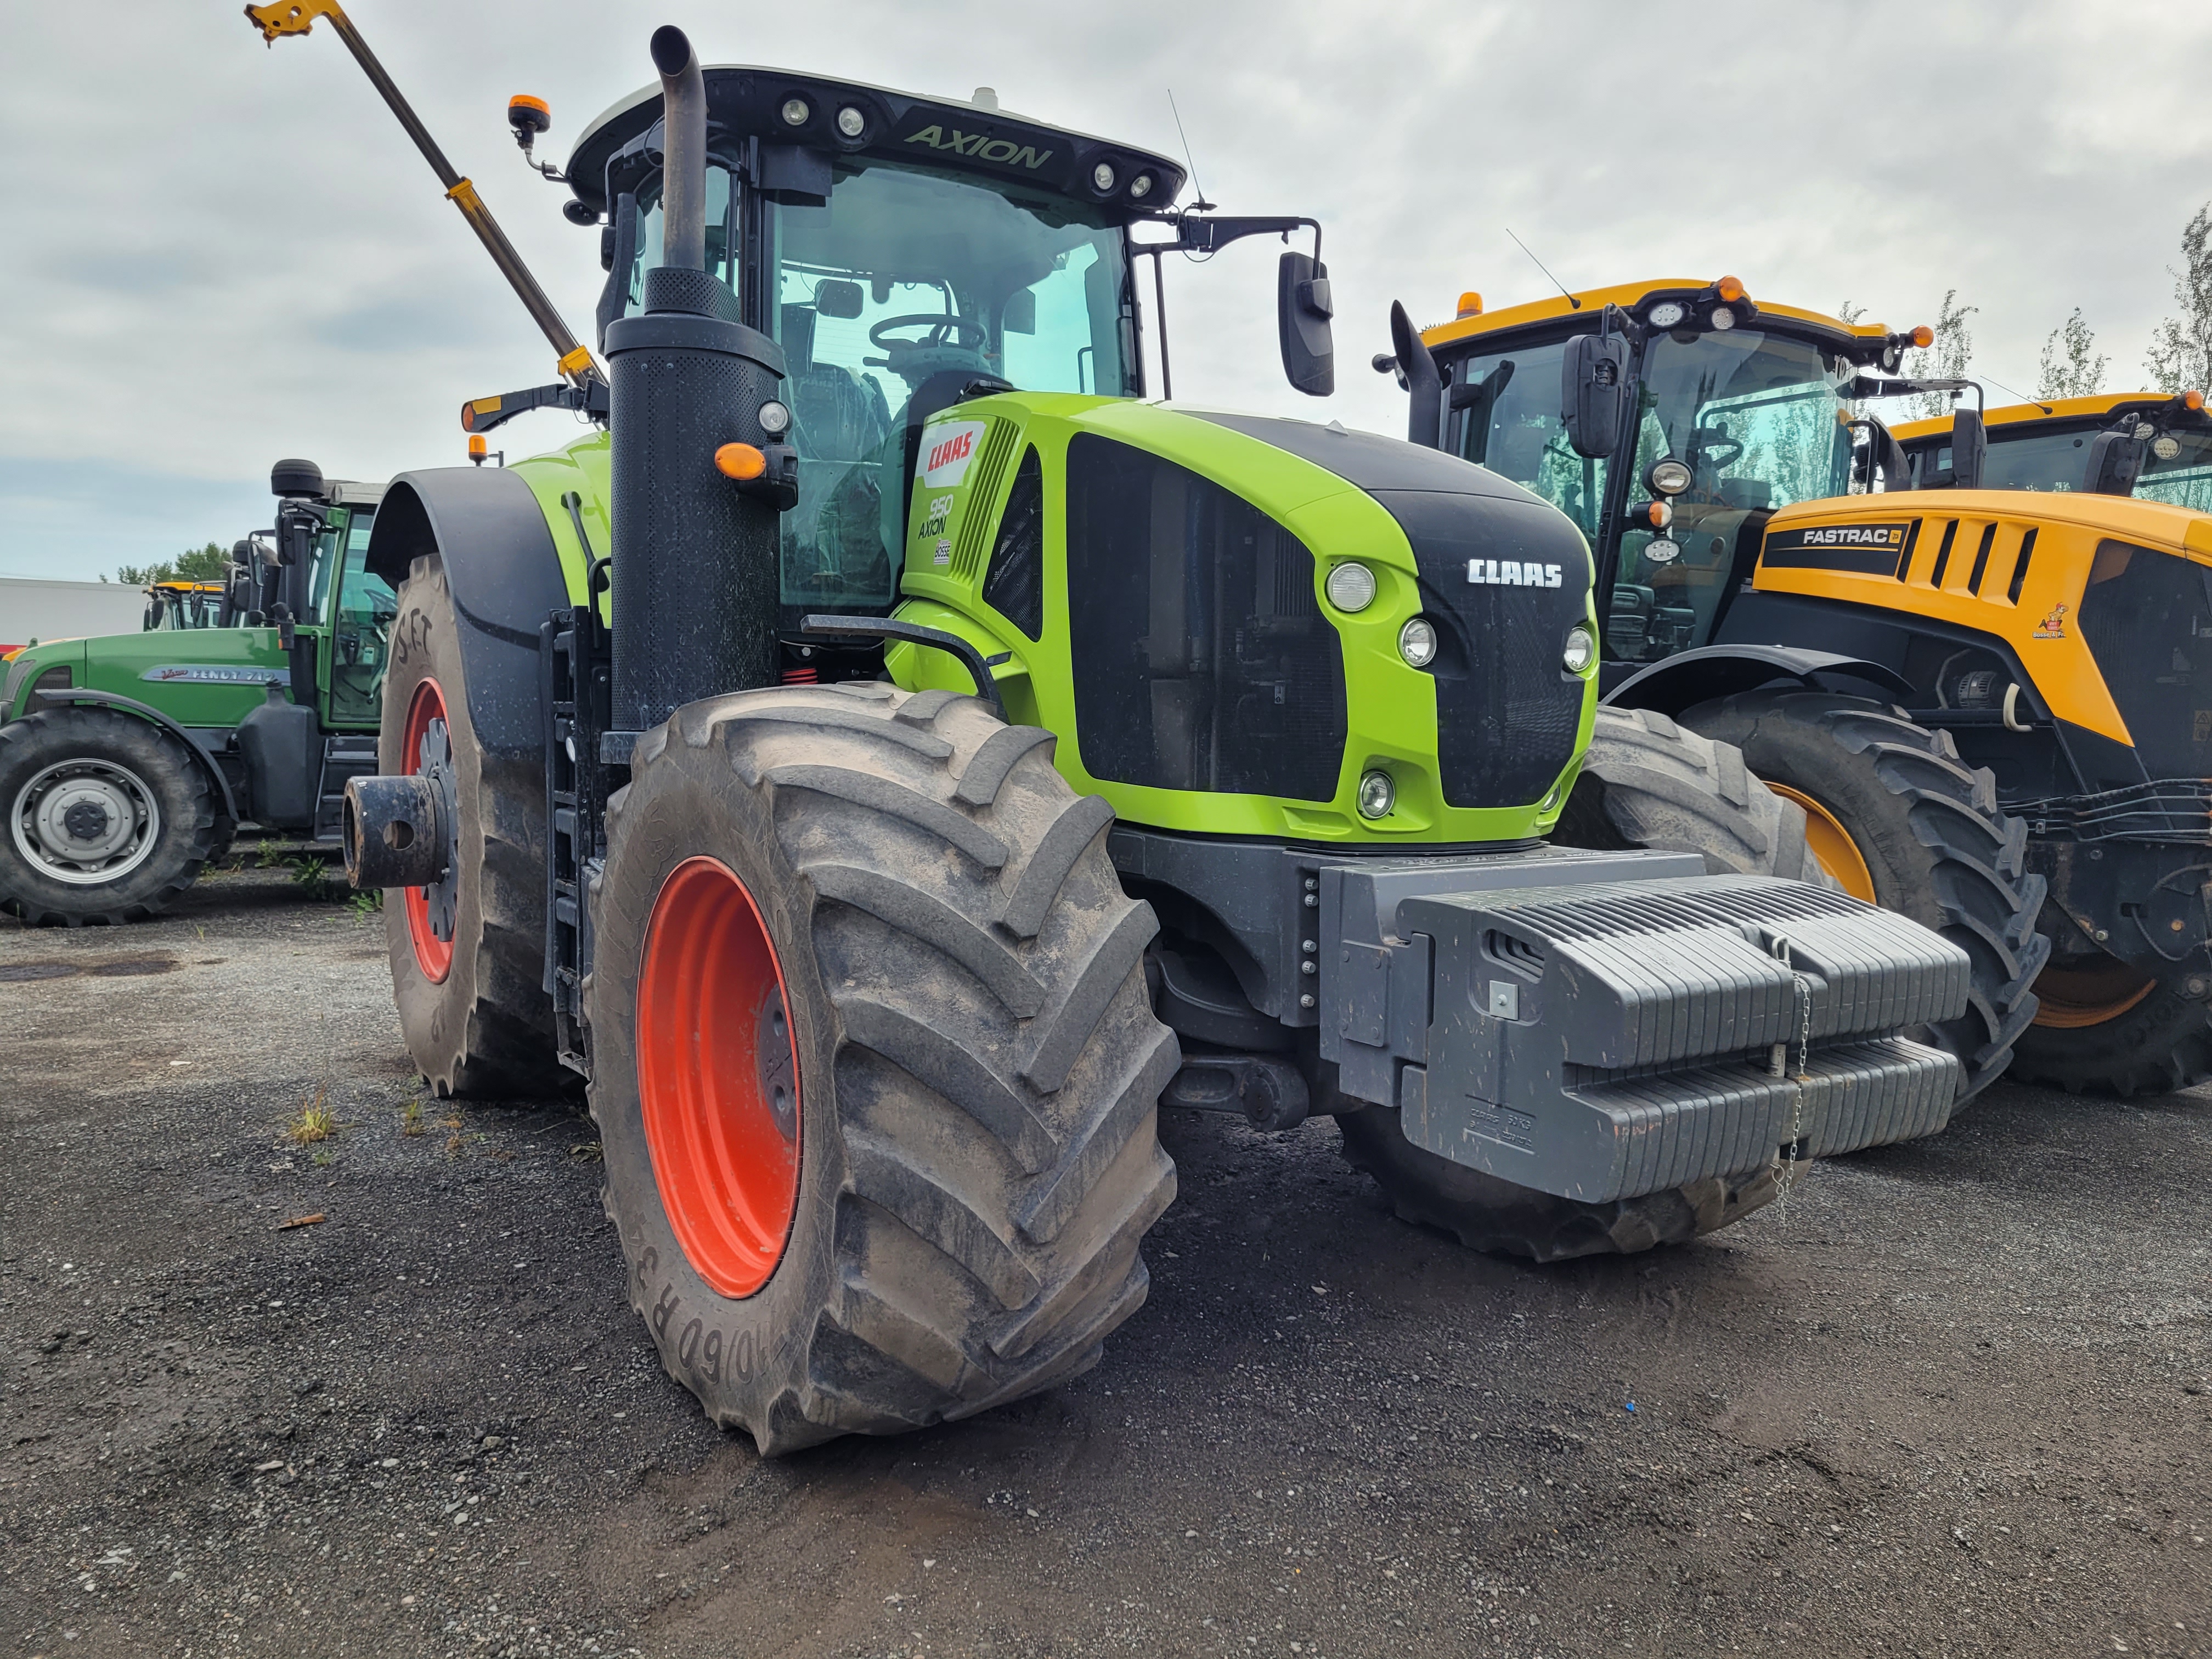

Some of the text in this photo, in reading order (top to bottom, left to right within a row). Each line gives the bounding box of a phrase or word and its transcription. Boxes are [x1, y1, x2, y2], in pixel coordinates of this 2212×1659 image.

[904, 125, 1054, 170] AXION
[928, 430, 973, 472] CLAAS
[928, 493, 954, 520] 950
[917, 516, 947, 540] AXION
[1803, 529, 1888, 544] FASTRAC
[1467, 558, 1562, 588] CLAAS
[192, 670, 241, 680] FENDT
